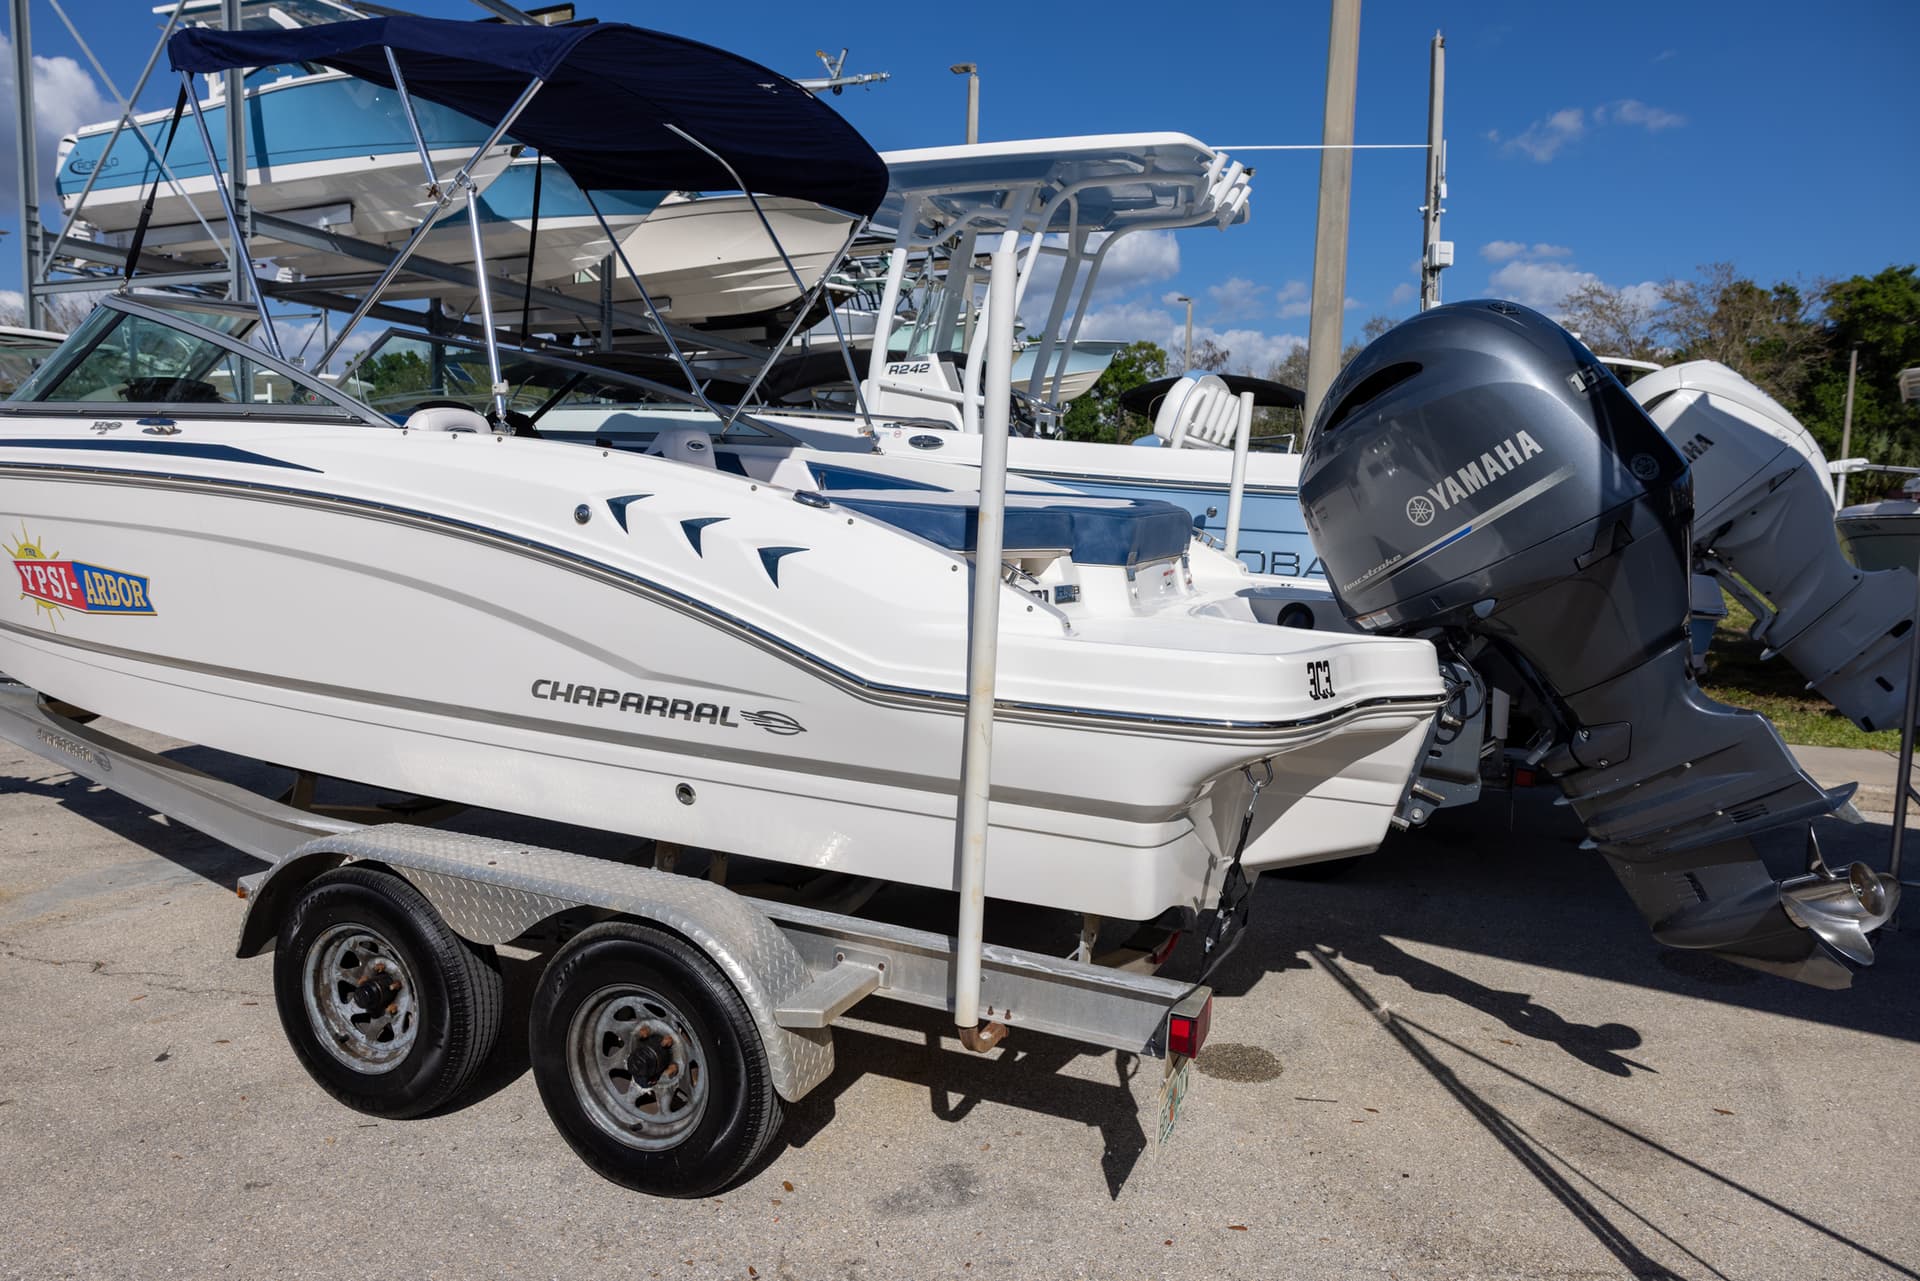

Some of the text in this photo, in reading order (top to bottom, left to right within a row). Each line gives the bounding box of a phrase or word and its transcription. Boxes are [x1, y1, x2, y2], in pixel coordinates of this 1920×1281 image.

[889, 363, 931, 375] R242
[1427, 430, 1543, 510] YAMAHA
[19, 565, 147, 607] YPSI- ARBOR
[531, 679, 738, 728] CHAPARRAL
